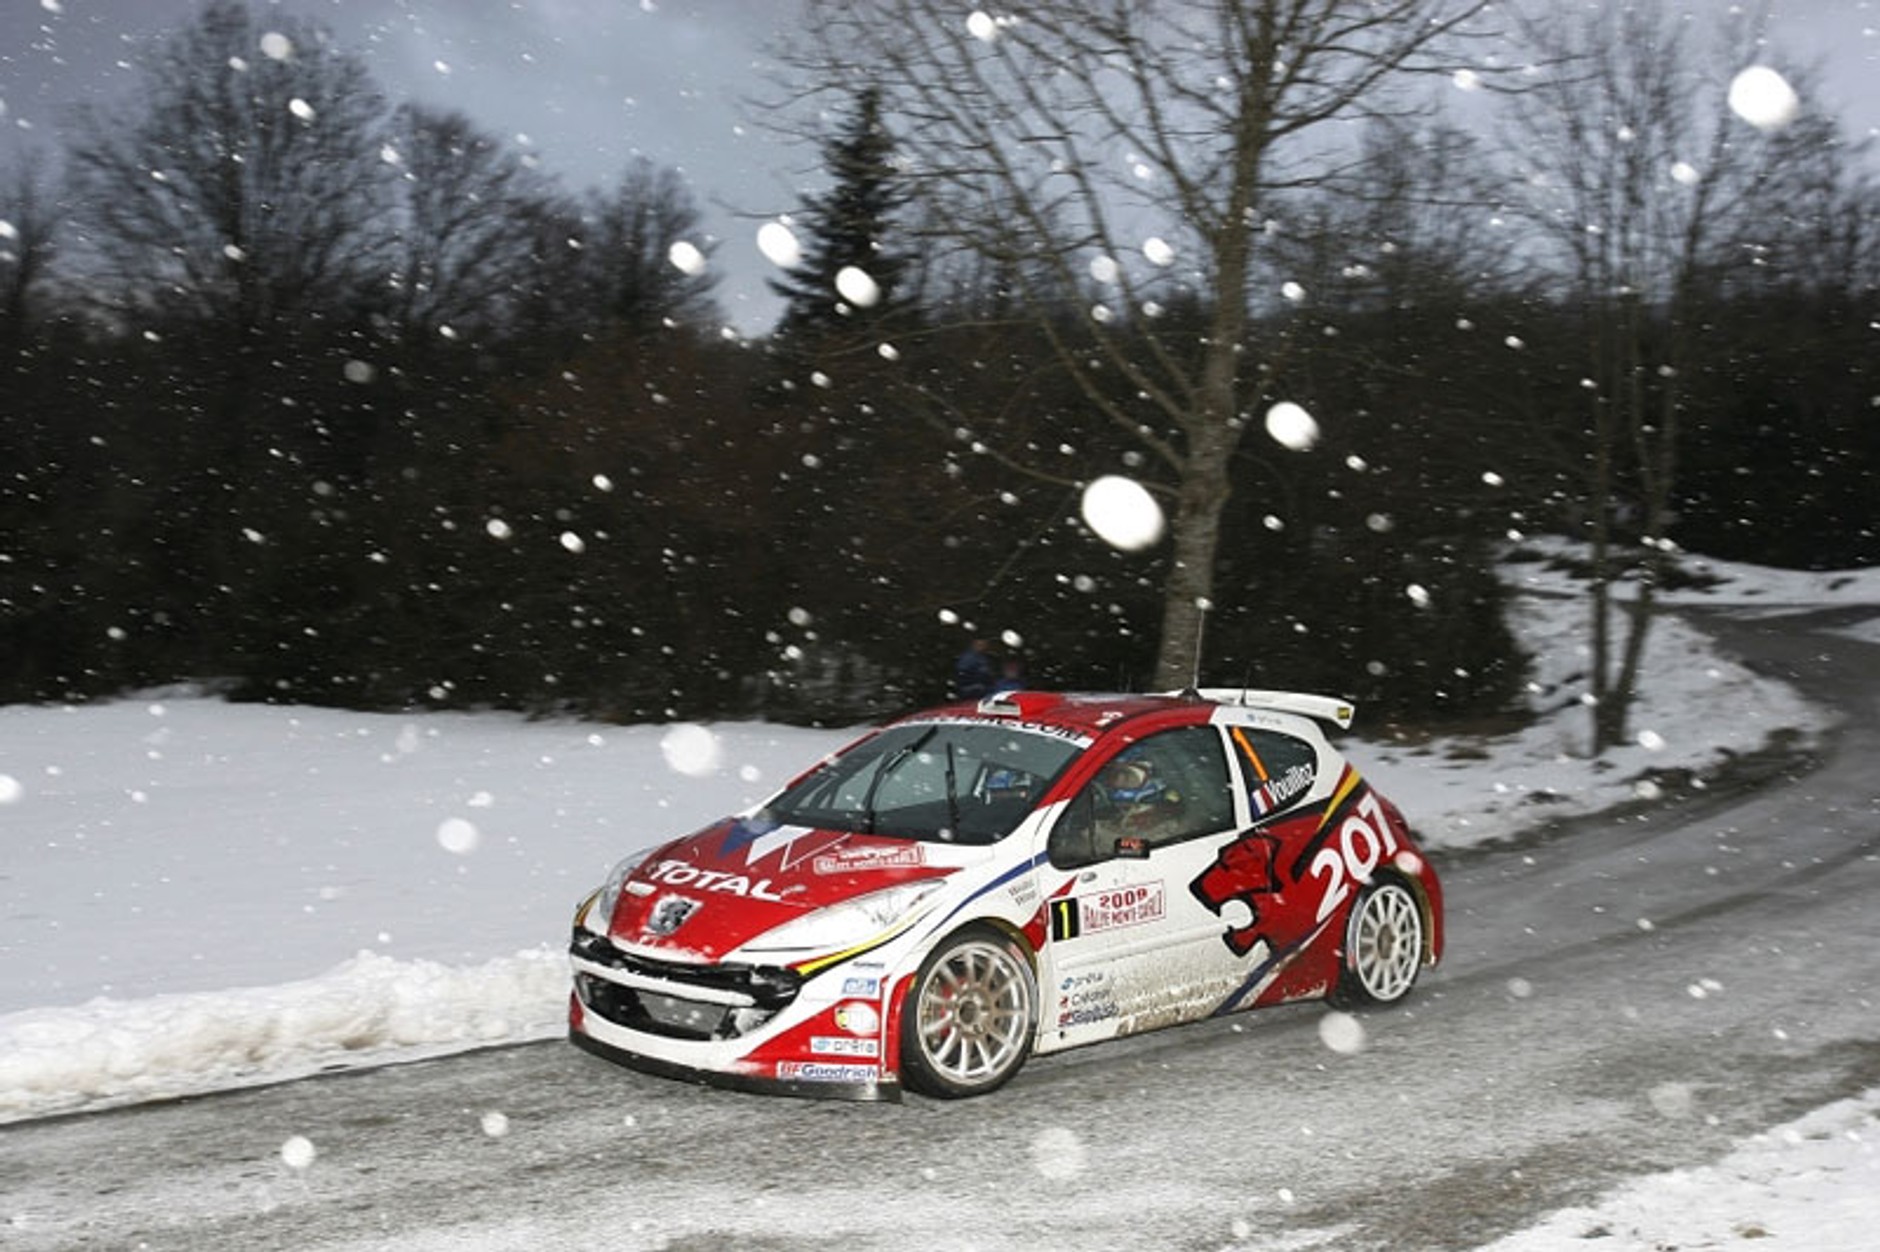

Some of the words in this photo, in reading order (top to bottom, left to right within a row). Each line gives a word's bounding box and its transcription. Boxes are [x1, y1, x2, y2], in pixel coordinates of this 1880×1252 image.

[1311, 791, 1398, 923] 207
[651, 859, 782, 901] TOTAL
[1099, 888, 1148, 910] 2009
[1059, 901, 1071, 940] 1
[779, 1062, 878, 1080] BFGoodrich
